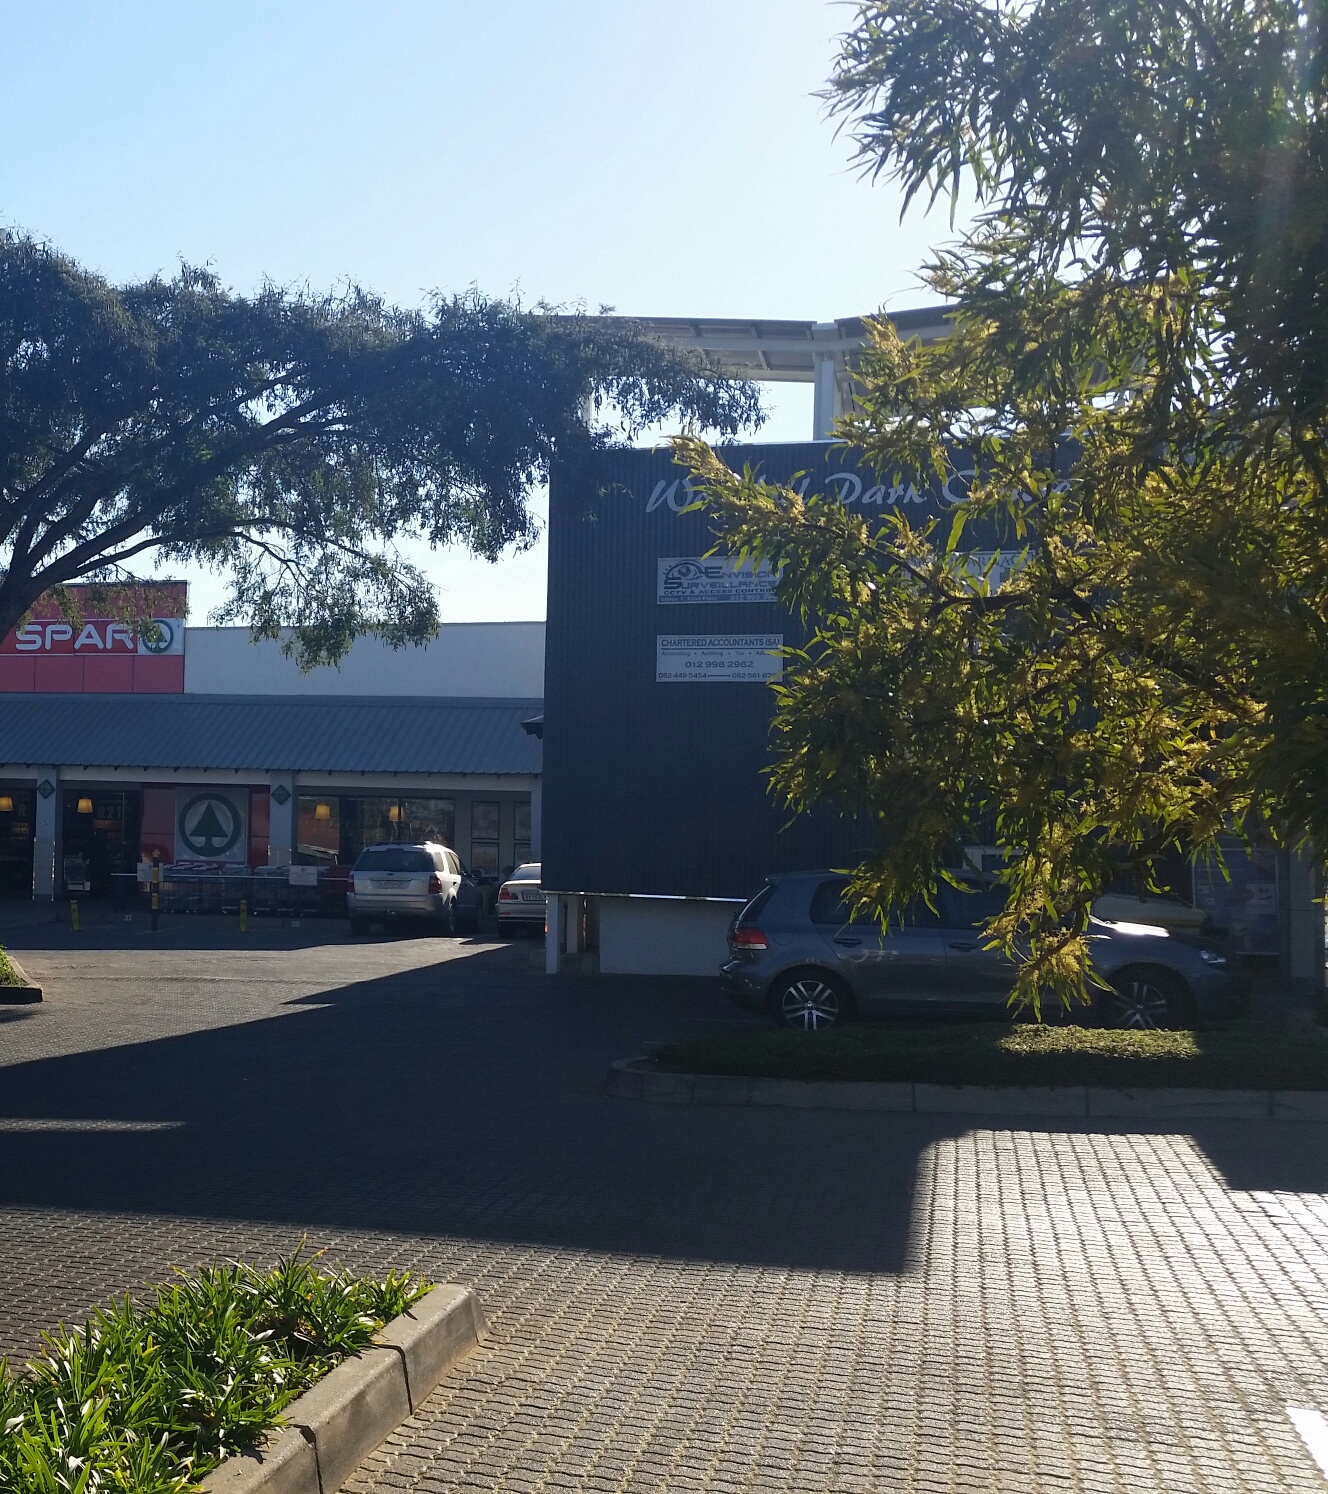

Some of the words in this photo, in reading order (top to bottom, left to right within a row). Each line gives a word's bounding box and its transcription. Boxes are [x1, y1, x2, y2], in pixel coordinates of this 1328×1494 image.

[15, 623, 134, 651] SPAR
[661, 638, 706, 647] CHARTERED
[708, 638, 764, 647] ACCOUNTANTS
[765, 637, 780, 647] (SA)
